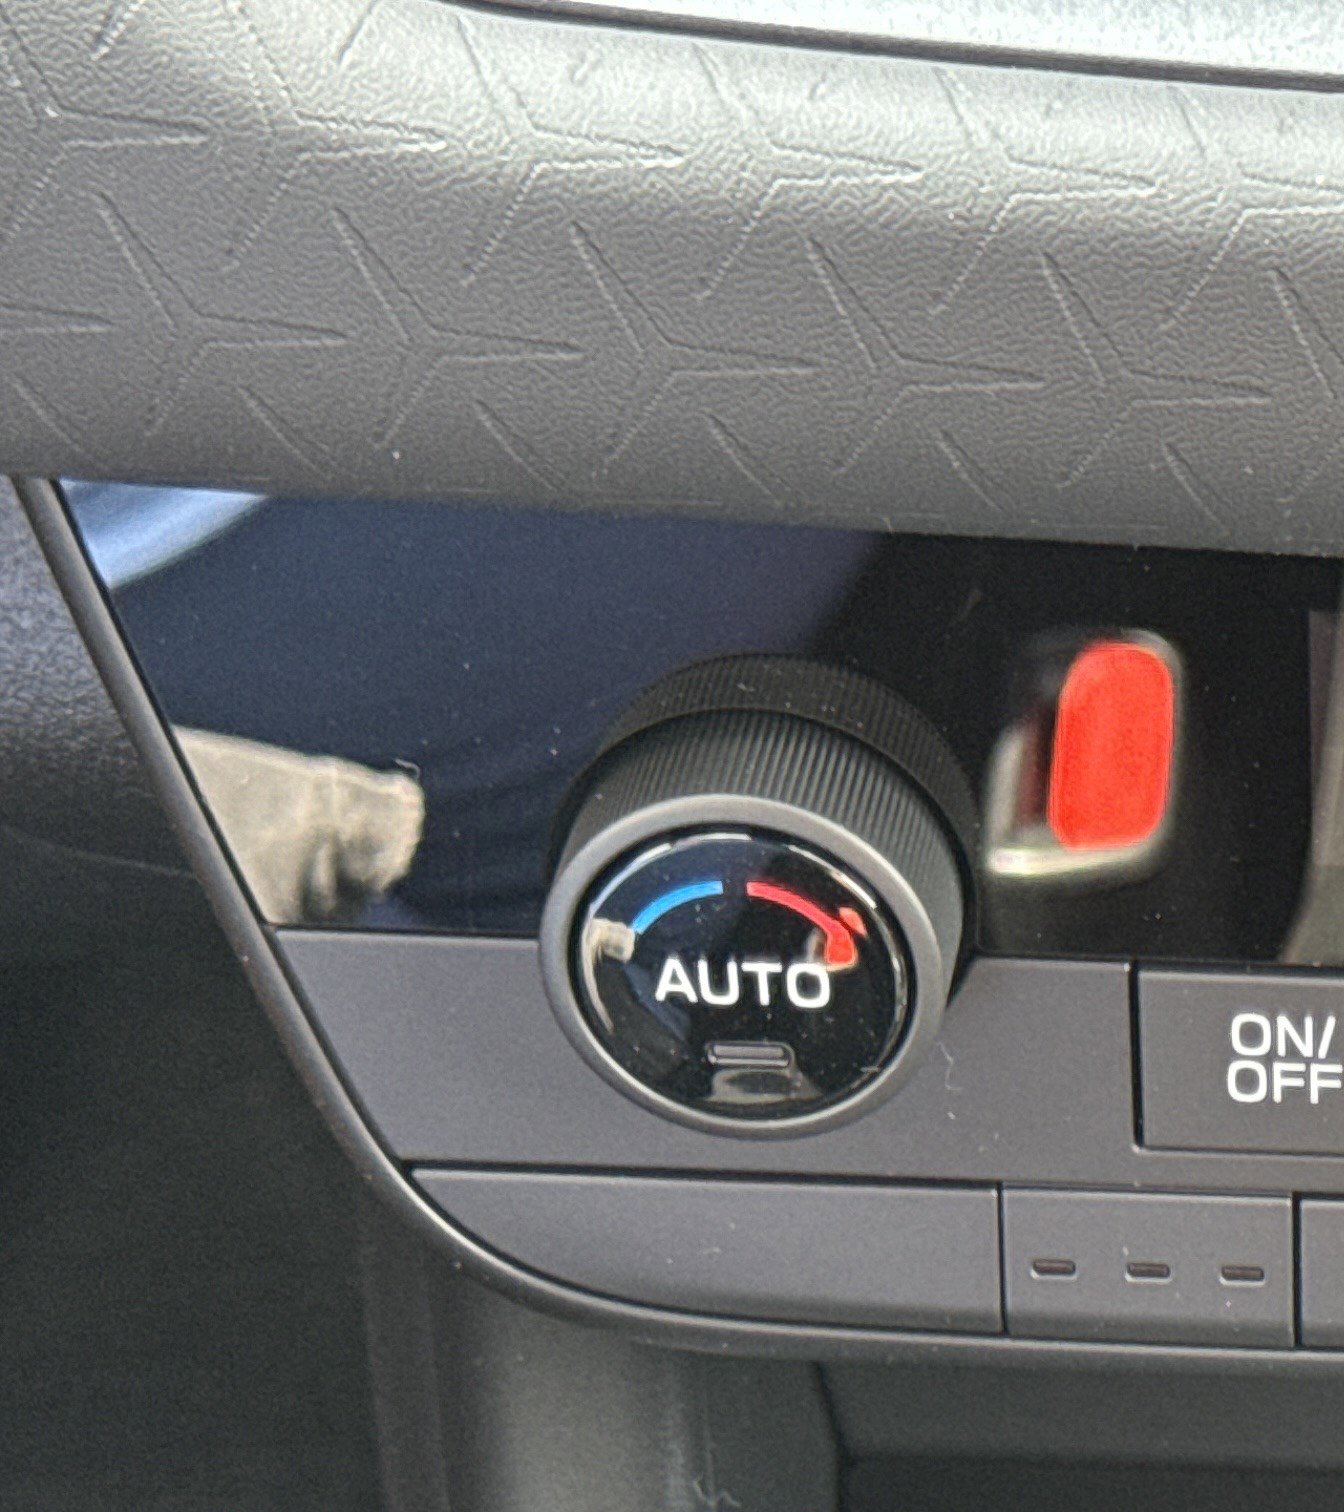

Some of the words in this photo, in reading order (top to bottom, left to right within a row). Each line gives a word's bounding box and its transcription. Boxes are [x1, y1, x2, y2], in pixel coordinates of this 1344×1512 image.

[654, 959, 831, 1010] AUTO
[1229, 1012, 1336, 1059] ON/
[1227, 1061, 1343, 1105] OFF
